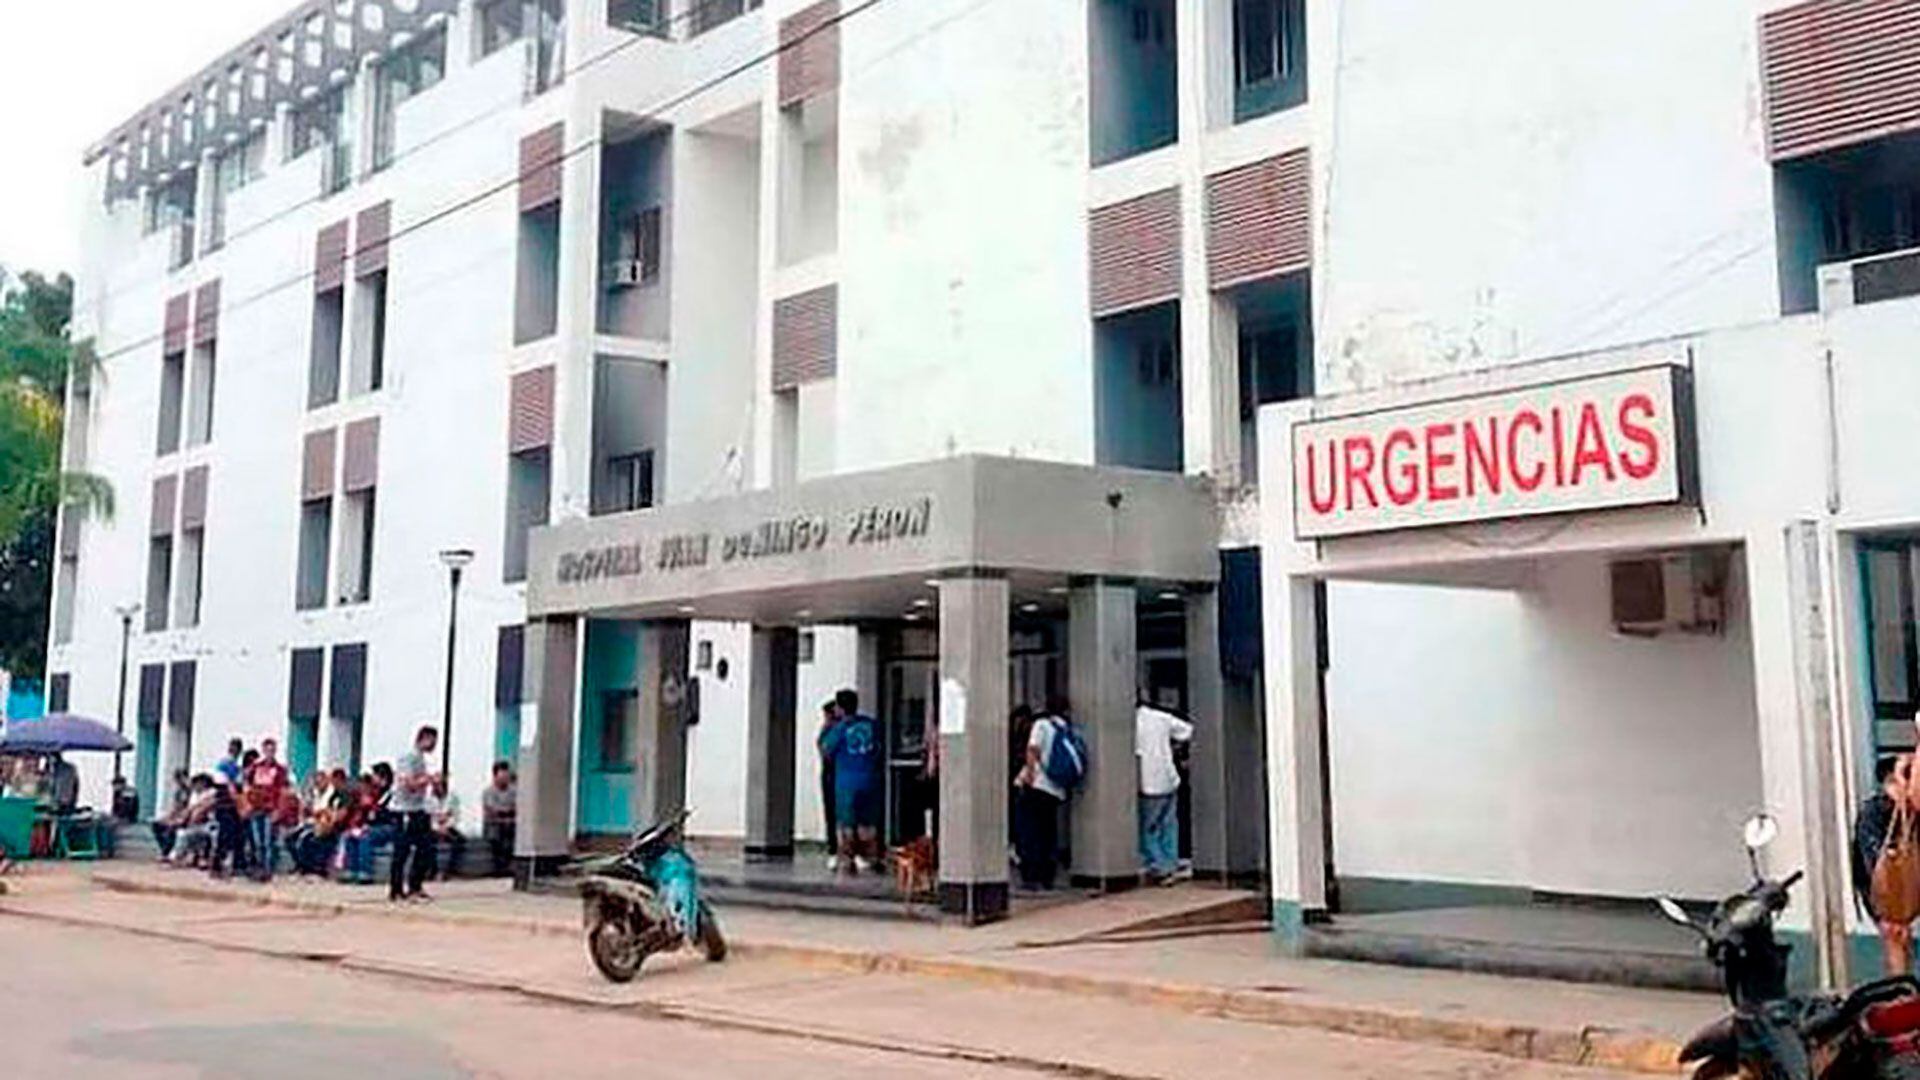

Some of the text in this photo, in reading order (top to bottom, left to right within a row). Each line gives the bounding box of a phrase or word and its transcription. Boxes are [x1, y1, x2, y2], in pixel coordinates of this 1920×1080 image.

[1307, 394, 1659, 515] URGENCIAS
[657, 534, 710, 570] JUAN
[722, 519, 828, 562] DOMINGO
